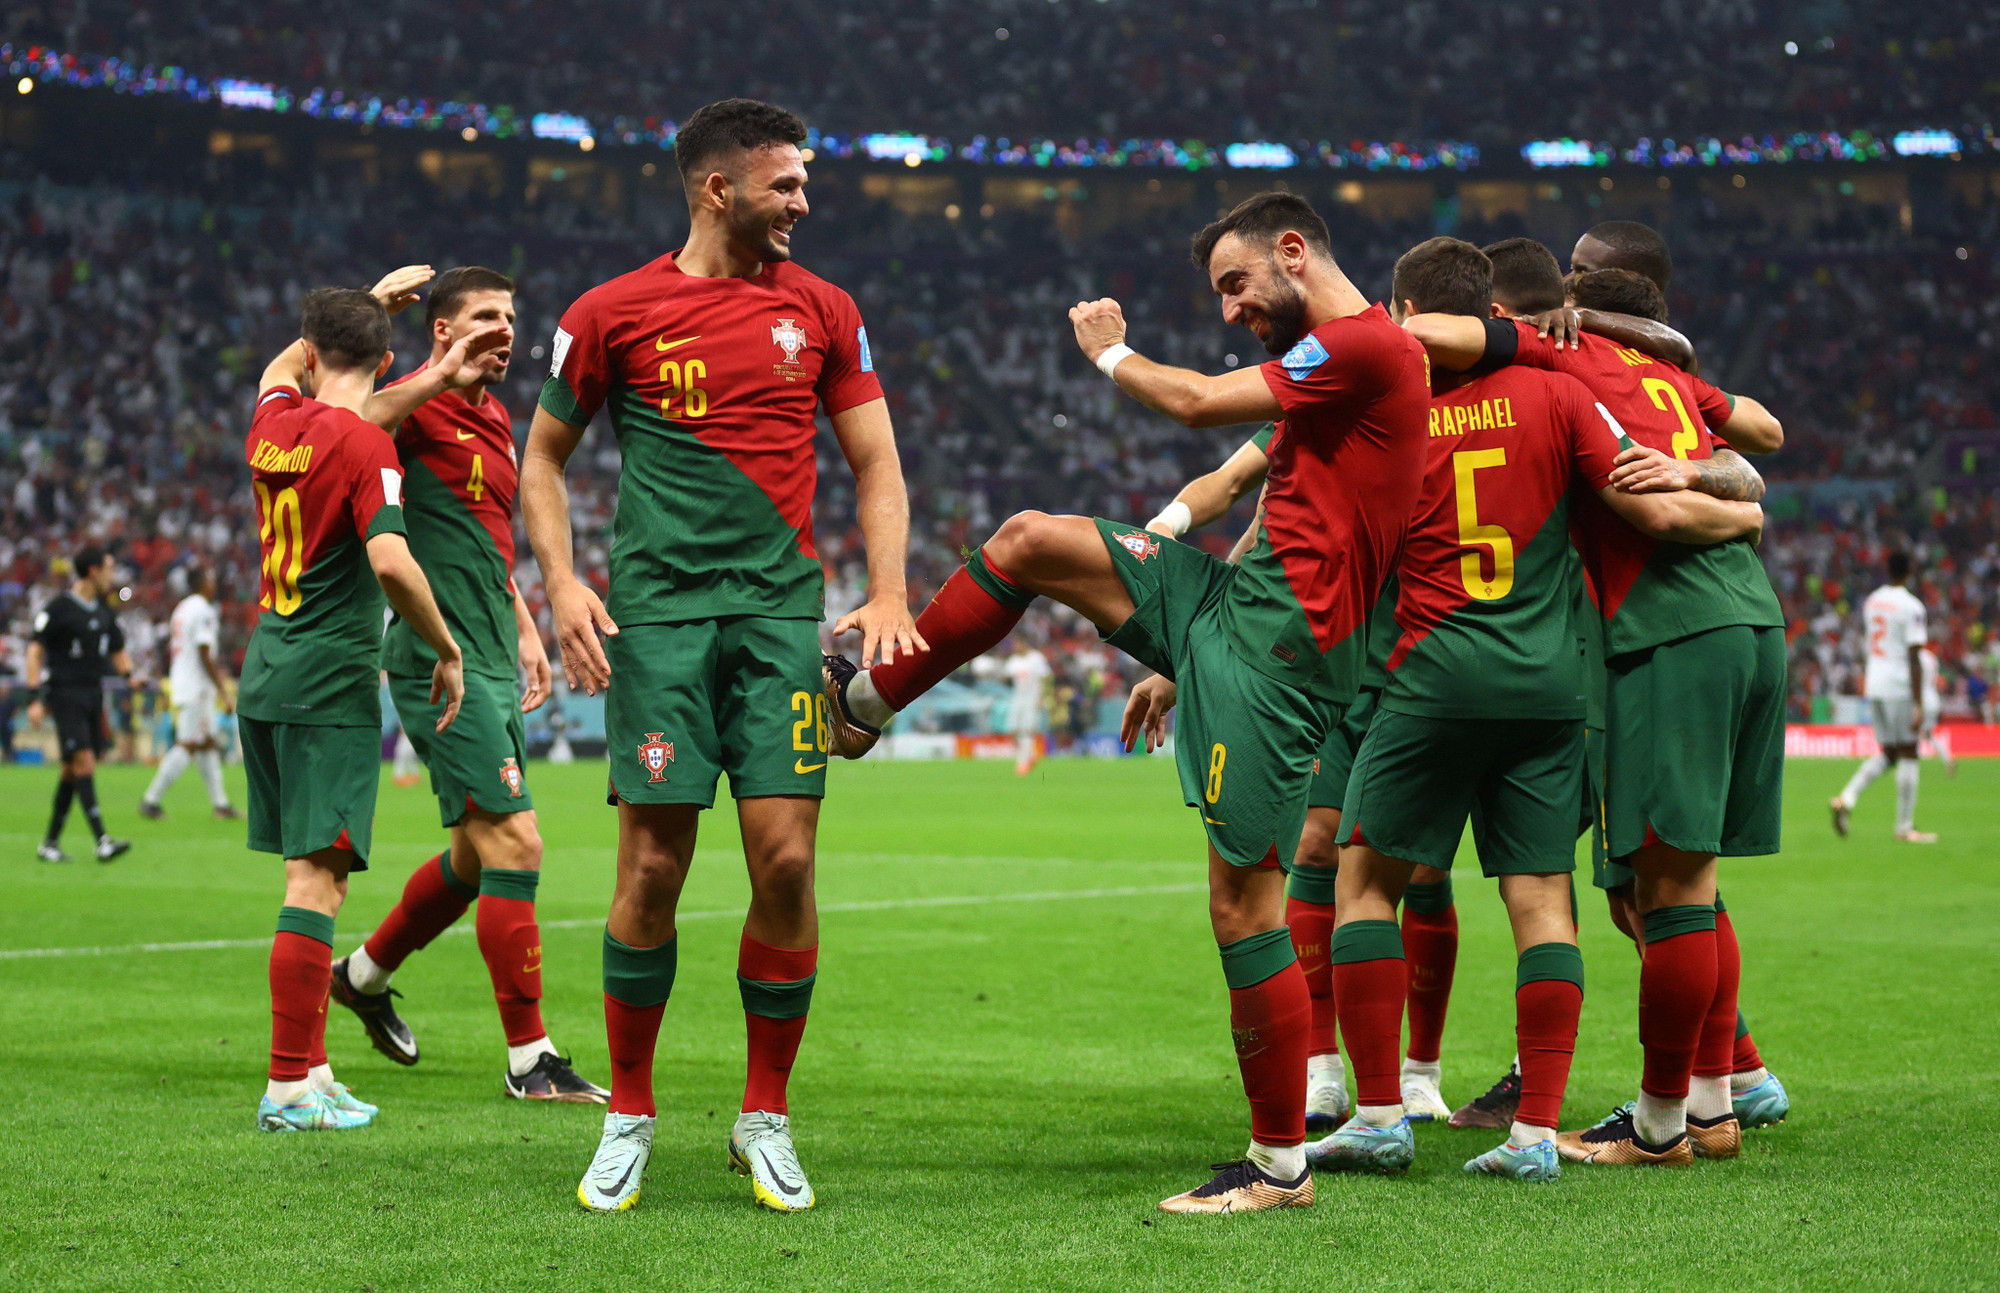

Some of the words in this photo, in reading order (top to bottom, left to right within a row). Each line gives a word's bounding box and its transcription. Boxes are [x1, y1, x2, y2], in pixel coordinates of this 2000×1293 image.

[659, 359, 707, 418] 26
[1429, 397, 1517, 437] RAPHAEL
[1641, 376, 1698, 460] 2
[466, 454, 484, 501] 4
[1453, 447, 1515, 601] 5
[791, 691, 828, 753] 26
[1206, 742, 1227, 804] 8
